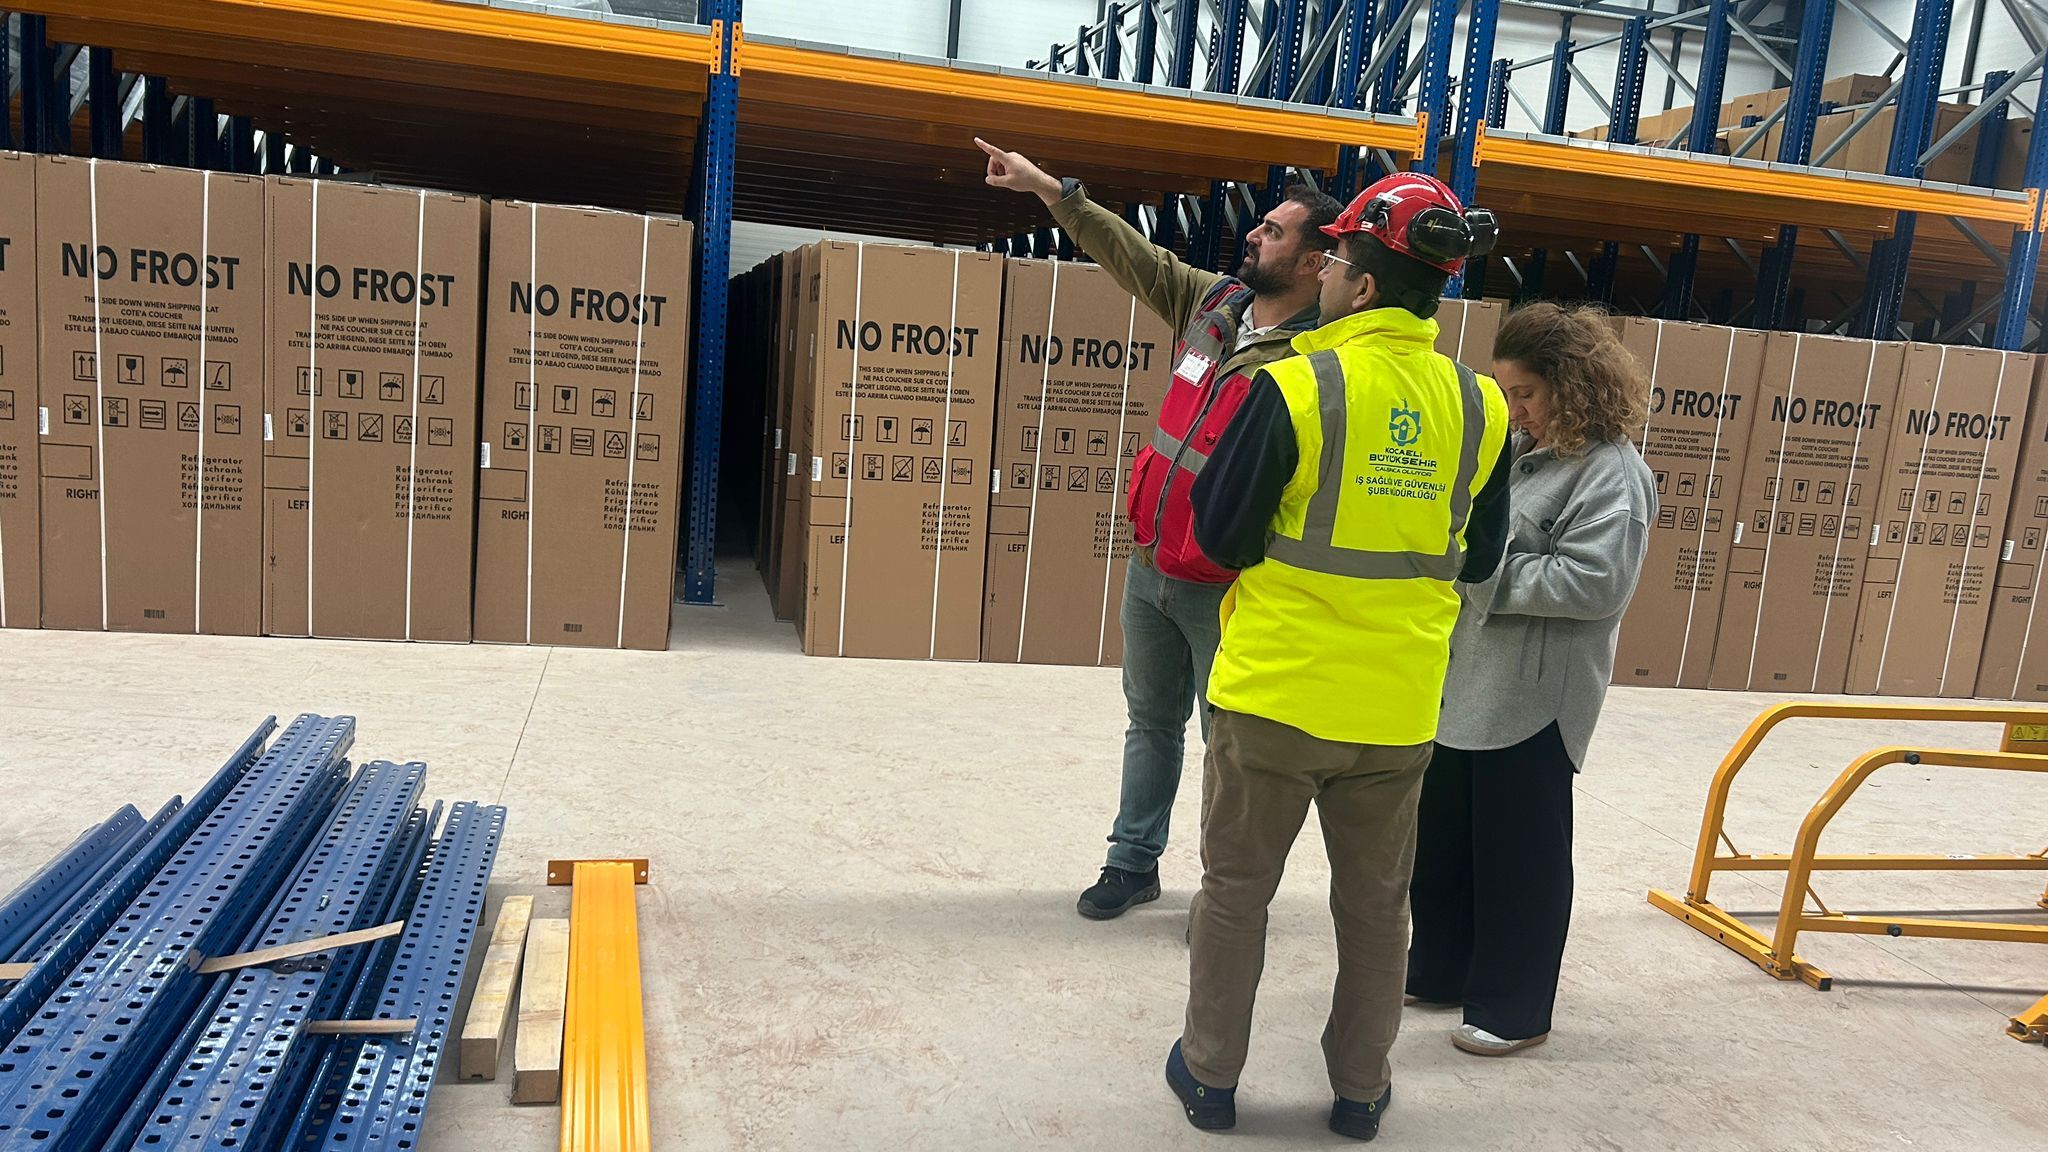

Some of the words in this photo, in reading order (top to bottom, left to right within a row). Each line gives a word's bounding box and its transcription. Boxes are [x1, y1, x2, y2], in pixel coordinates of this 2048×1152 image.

[62, 243, 117, 280] NO
[131, 248, 240, 290] FROST
[288, 262, 341, 298] NO
[353, 267, 455, 307] FROST
[101, 297, 117, 305] SIDE
[118, 299, 142, 307] DOWN
[144, 301, 166, 309] WHEN
[510, 281, 559, 316] NO
[570, 287, 667, 327] FROST
[149, 311, 183, 320] COUCHER
[112, 318, 145, 327] LIEGEND,
[168, 322, 187, 330] SEITE
[210, 326, 235, 334] UNTEN
[358, 317, 379, 325] WHEN
[380, 319, 412, 327] SHIPPING
[64, 324, 81, 332] ESTE
[104, 327, 129, 335] ABAJO
[130, 329, 162, 337] CUANDO
[346, 326, 379, 334] COUCHER
[336, 335, 368, 343] LIEGEND,
[388, 338, 406, 346] SEITE
[428, 341, 447, 349] OBEN
[543, 332, 557, 340] SIDE
[558, 334, 579, 342] DOWN
[580, 336, 599, 344] WHEN
[601, 338, 630, 347] SHIPPING
[837, 319, 882, 352] NO
[891, 323, 979, 358] FROST
[288, 340, 304, 348] ESTE
[326, 343, 351, 351] ARRIBA
[352, 344, 381, 353] CUANDO
[383, 348, 416, 356] EMBARQU
[421, 350, 453, 359] TUMBADO
[583, 345, 614, 354] COUCHER
[1020, 334, 1063, 366] NO
[1071, 337, 1155, 371] FROST
[551, 352, 580, 360] LIEGEND,
[581, 354, 599, 362] DIESE
[600, 356, 617, 364] SEITE
[544, 360, 565, 368] ABAJO
[567, 362, 594, 371] CUANDO
[596, 365, 629, 374] EMBARQUE
[1092, 382, 1117, 390] SHIPPING
[915, 396, 946, 404] EMBARQUE
[1671, 389, 1742, 420] FROST
[1067, 406, 1092, 414] CUANDO
[1771, 395, 1807, 424] NO
[1812, 398, 1881, 430] FROST
[1906, 409, 1941, 436] NO
[1944, 412, 2011, 441] FROST
[1369, 453, 1437, 468] BÜYÜKŞEHİR
[1355, 474, 1364, 485] İŞ
[1393, 479, 1403, 487] VE
[66, 488, 99, 500] RIGHT
[1367, 486, 1389, 496] ŞUBE
[287, 500, 310, 510] LEFT
[501, 510, 530, 521] RIGHT
[830, 536, 849, 545] LEFT
[1007, 543, 1027, 552] LEFT
[1877, 591, 1893, 599] LEFT
[2012, 595, 2031, 604] RIGHT
